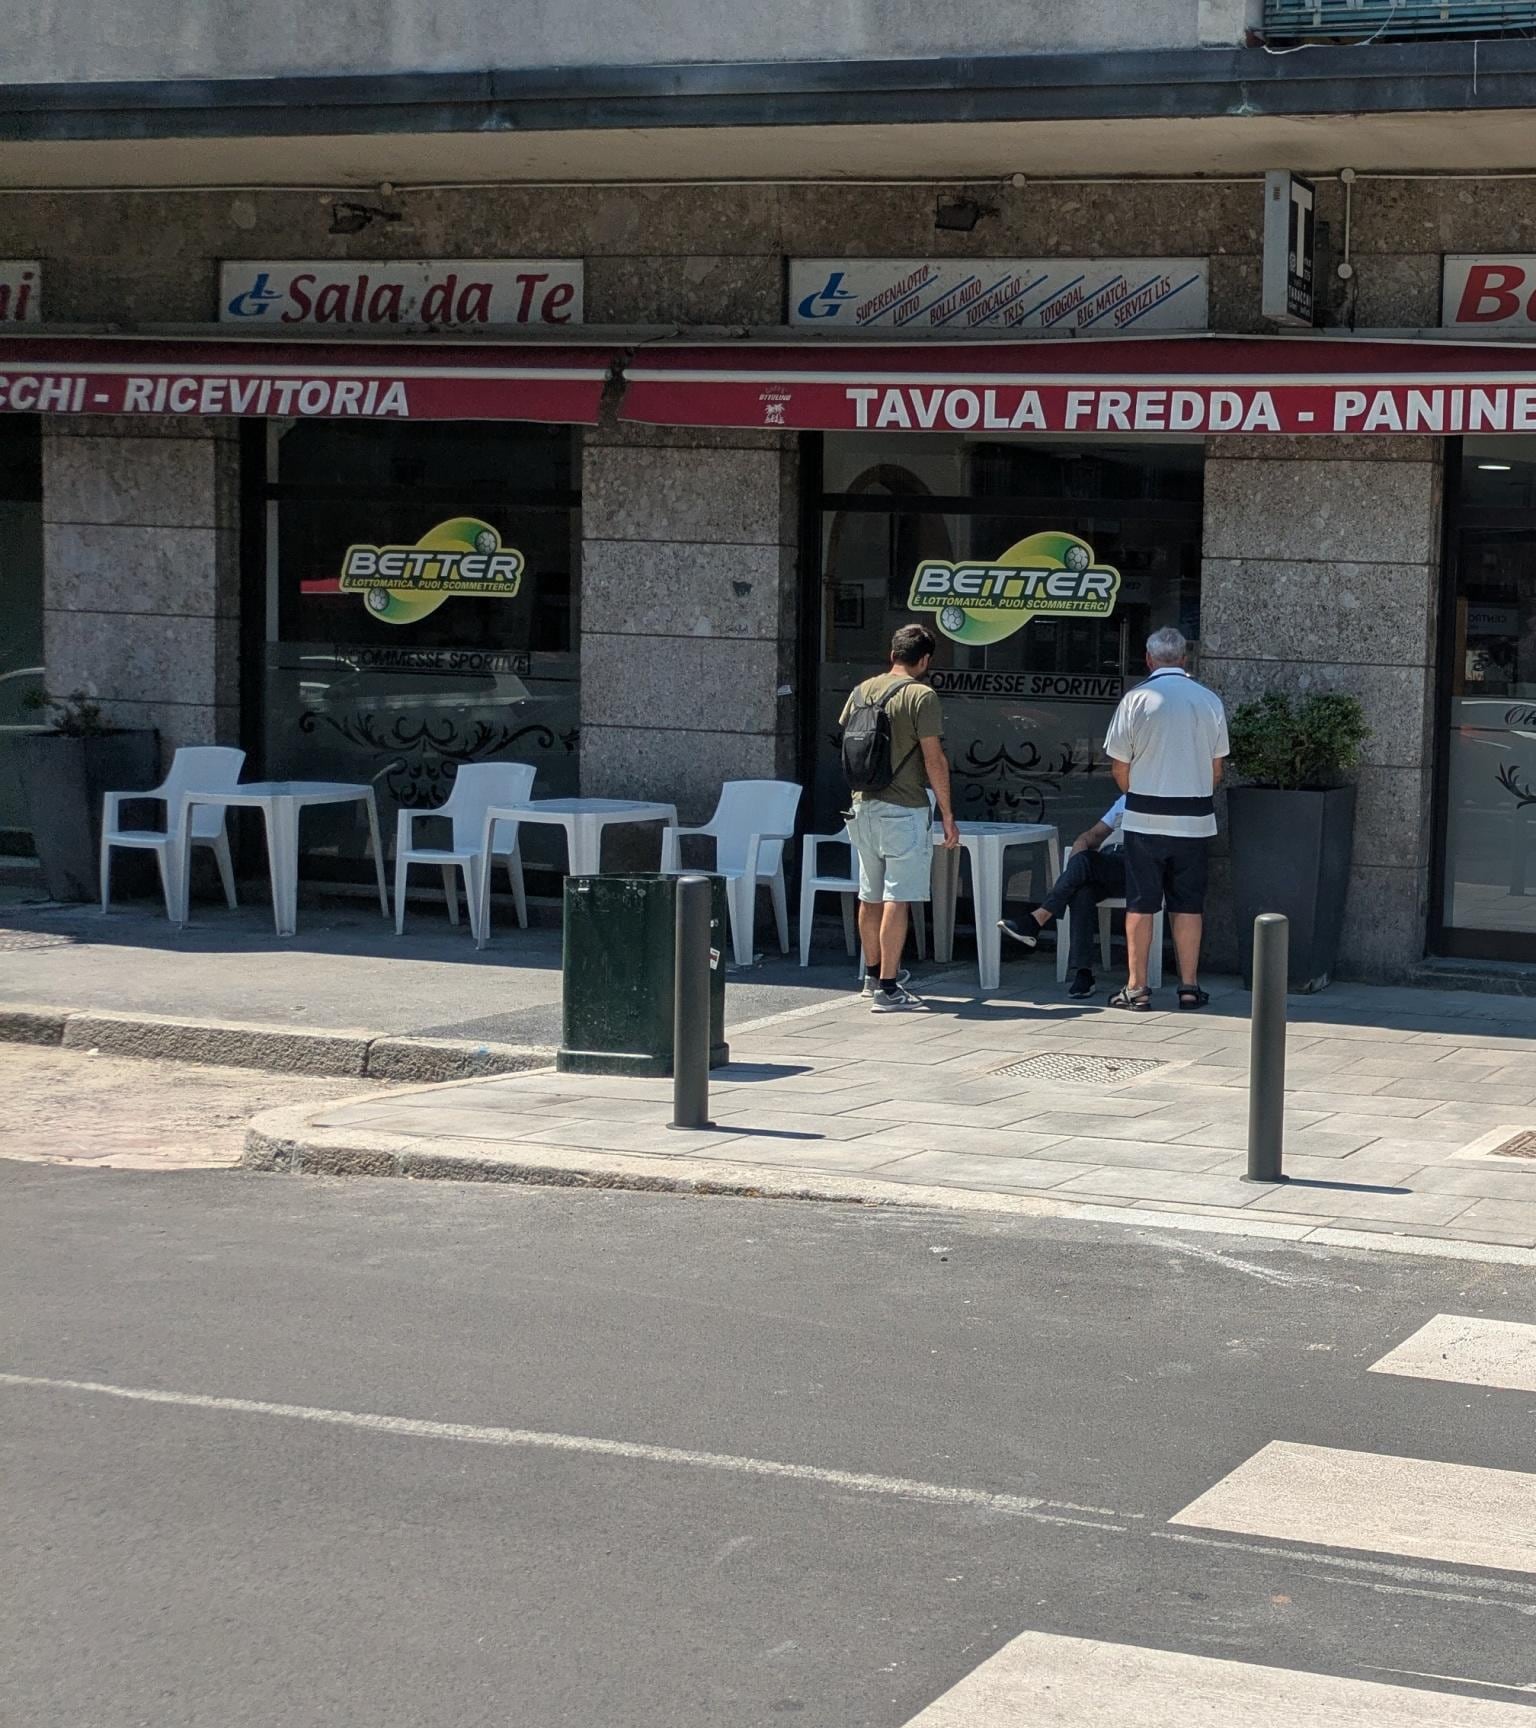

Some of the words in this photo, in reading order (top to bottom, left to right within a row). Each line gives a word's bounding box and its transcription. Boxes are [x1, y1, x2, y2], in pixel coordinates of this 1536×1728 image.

[281, 274, 404, 324] Sala
[420, 273, 494, 323] da
[515, 273, 575, 325] Te
[855, 263, 929, 325] SUPERENALOTTO
[959, 278, 982, 305] AUTO
[966, 278, 1021, 327] TOTOCALCIO
[1039, 286, 1085, 327] TOTOGOAL
[1077, 304, 1095, 328] BIG
[1095, 279, 1128, 315] MATCH
[892, 295, 920, 325] LOTTO
[1002, 302, 1025, 327] TRIS
[1113, 293, 1154, 328] SERVIZI
[122, 376, 410, 417] RICEVITORIA
[845, 387, 1048, 430] TAVOLA
[1063, 390, 1282, 433] FREDDA
[348, 552, 518, 579] BETTER
[418, 580, 442, 589] PUOI
[442, 581, 514, 592] SCOMMETTERCI
[917, 568, 1114, 598] BETTER
[998, 599, 1024, 608] PUOI
[1026, 600, 1109, 611] SCOMMETTERCI
[1030, 675, 1120, 697] SPORTIVE
